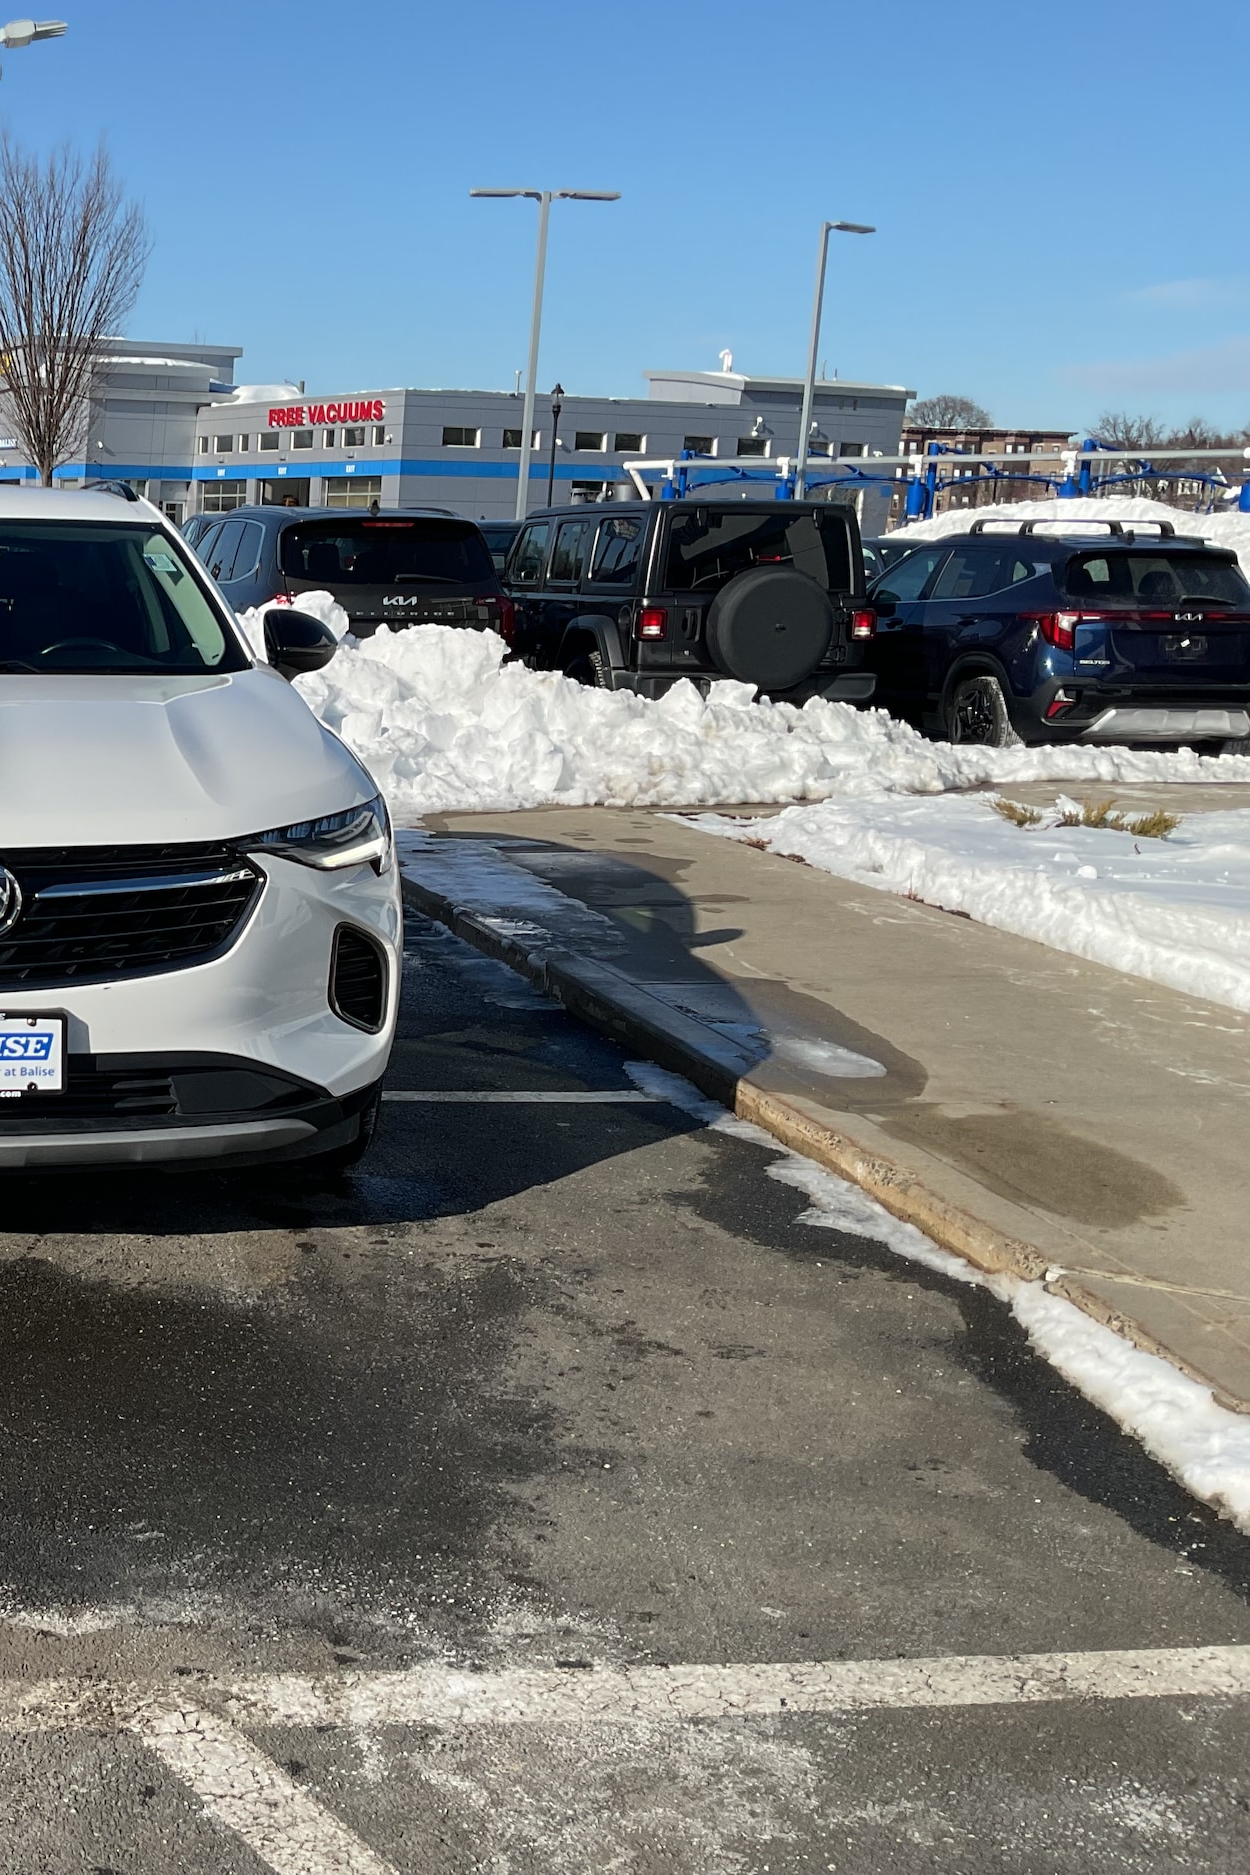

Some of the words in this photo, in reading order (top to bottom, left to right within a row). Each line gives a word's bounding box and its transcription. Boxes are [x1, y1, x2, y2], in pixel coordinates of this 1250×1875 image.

[268, 406, 305, 427] FREE
[308, 400, 385, 424] VACUUMS
[382, 596, 418, 606] KIA
[1174, 612, 1204, 621] KIA
[4, 1067, 17, 1077] at
[20, 1066, 55, 1077] Balise
